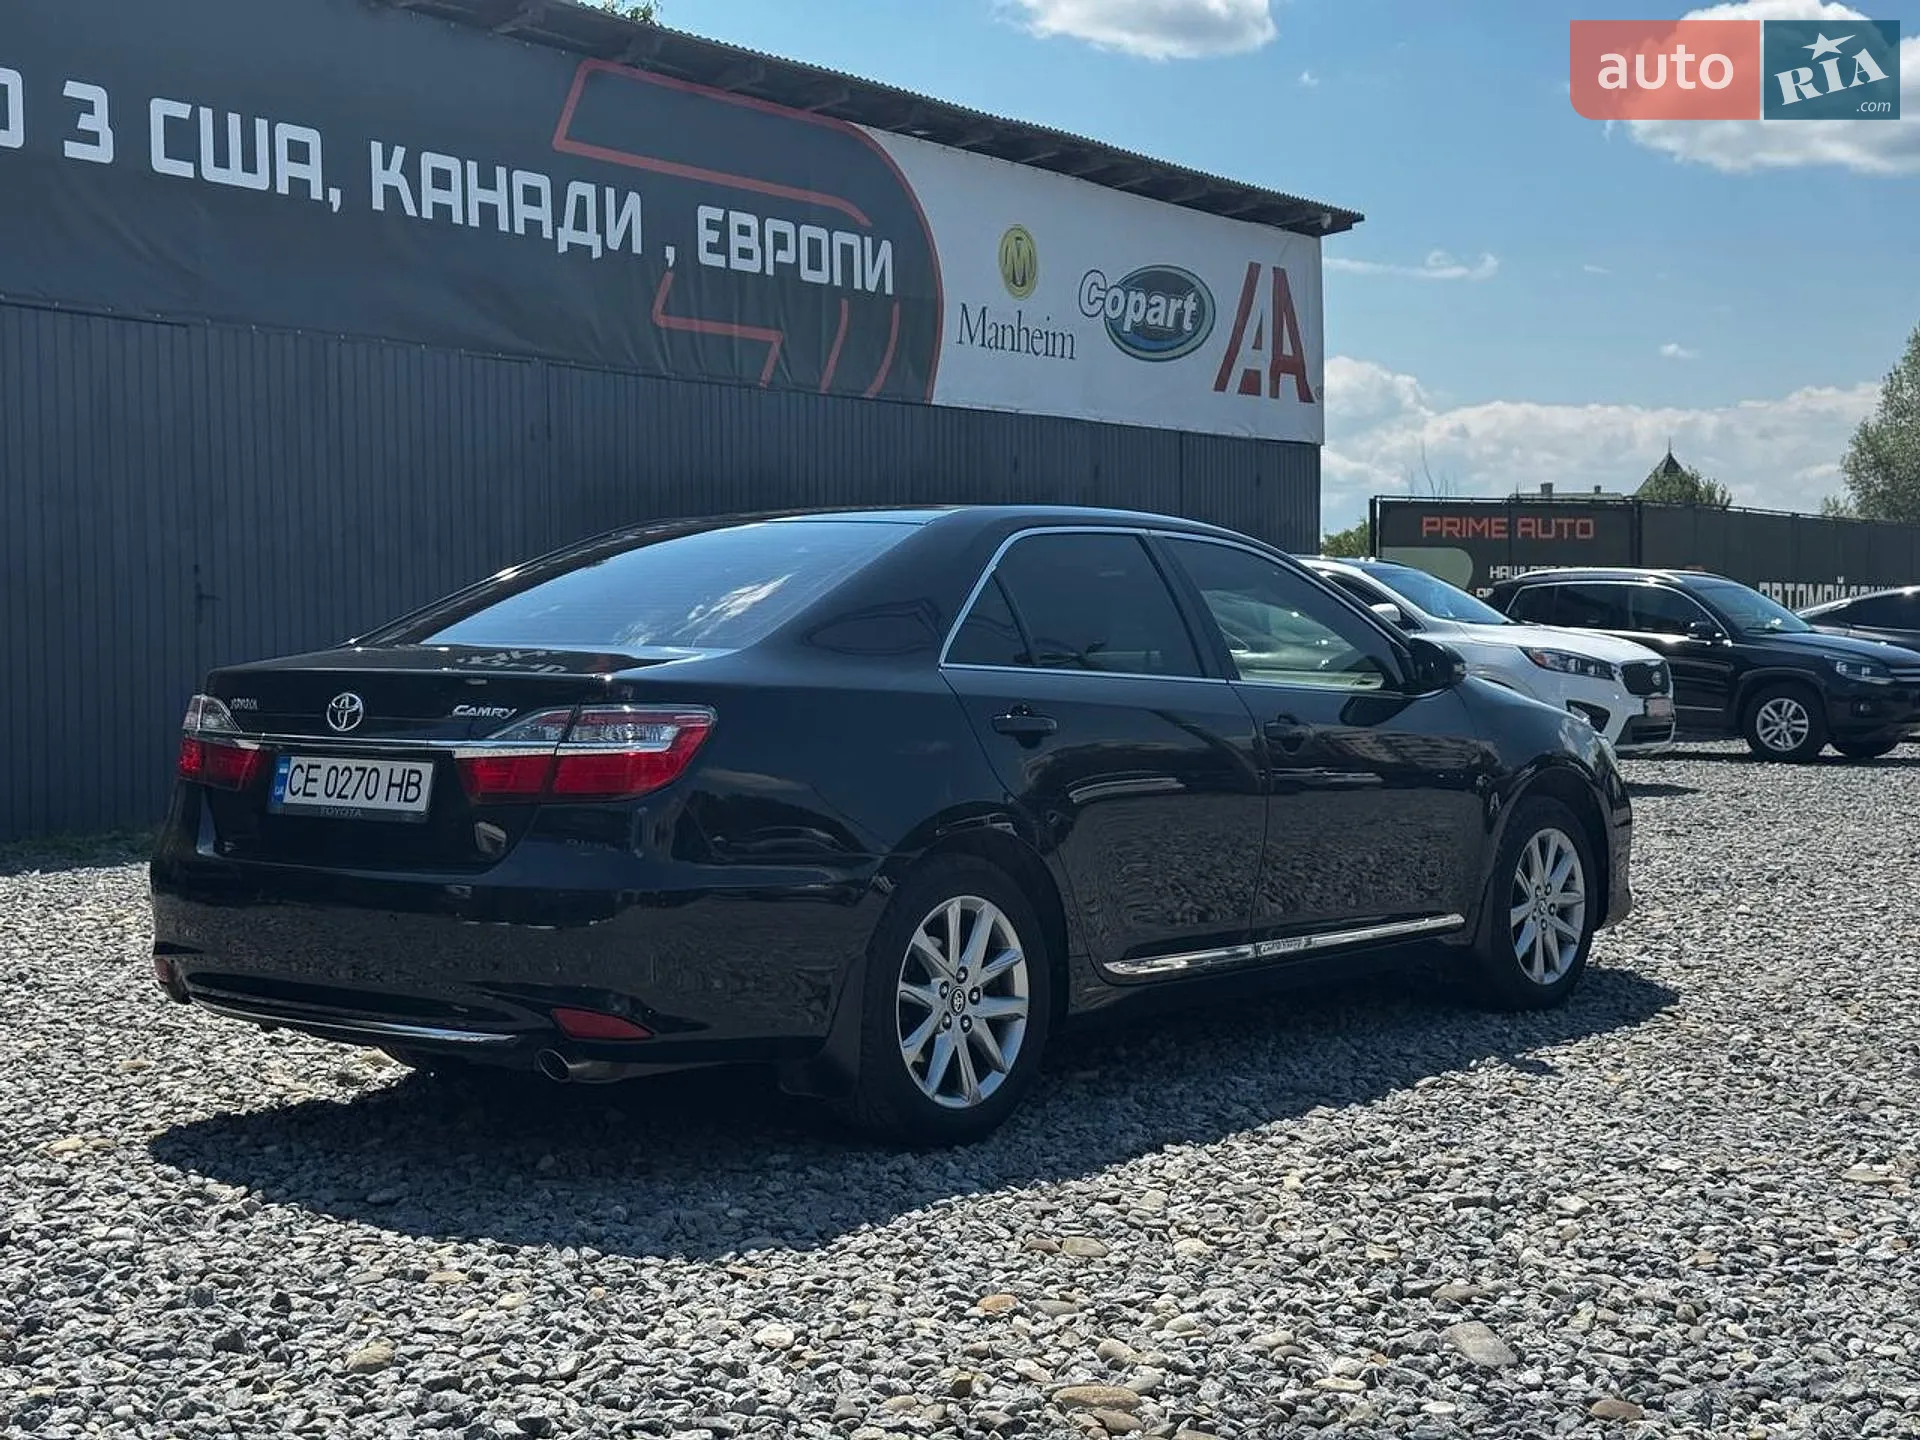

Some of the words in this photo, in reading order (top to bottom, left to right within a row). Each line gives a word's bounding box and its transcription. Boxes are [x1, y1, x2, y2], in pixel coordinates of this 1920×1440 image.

[150, 97, 342, 213] США,
[370, 140, 642, 259] КАНАДИ
[697, 205, 894, 295] ЕВРОПИ
[1079, 269, 1200, 336] Copart
[957, 303, 1076, 360] Manheim
[1422, 516, 1508, 539] PRIME
[1517, 517, 1595, 540] AUTO
[453, 705, 518, 719] CAMRY
[289, 764, 321, 797] CE
[324, 766, 380, 800] 0270
[385, 768, 422, 803] HB
